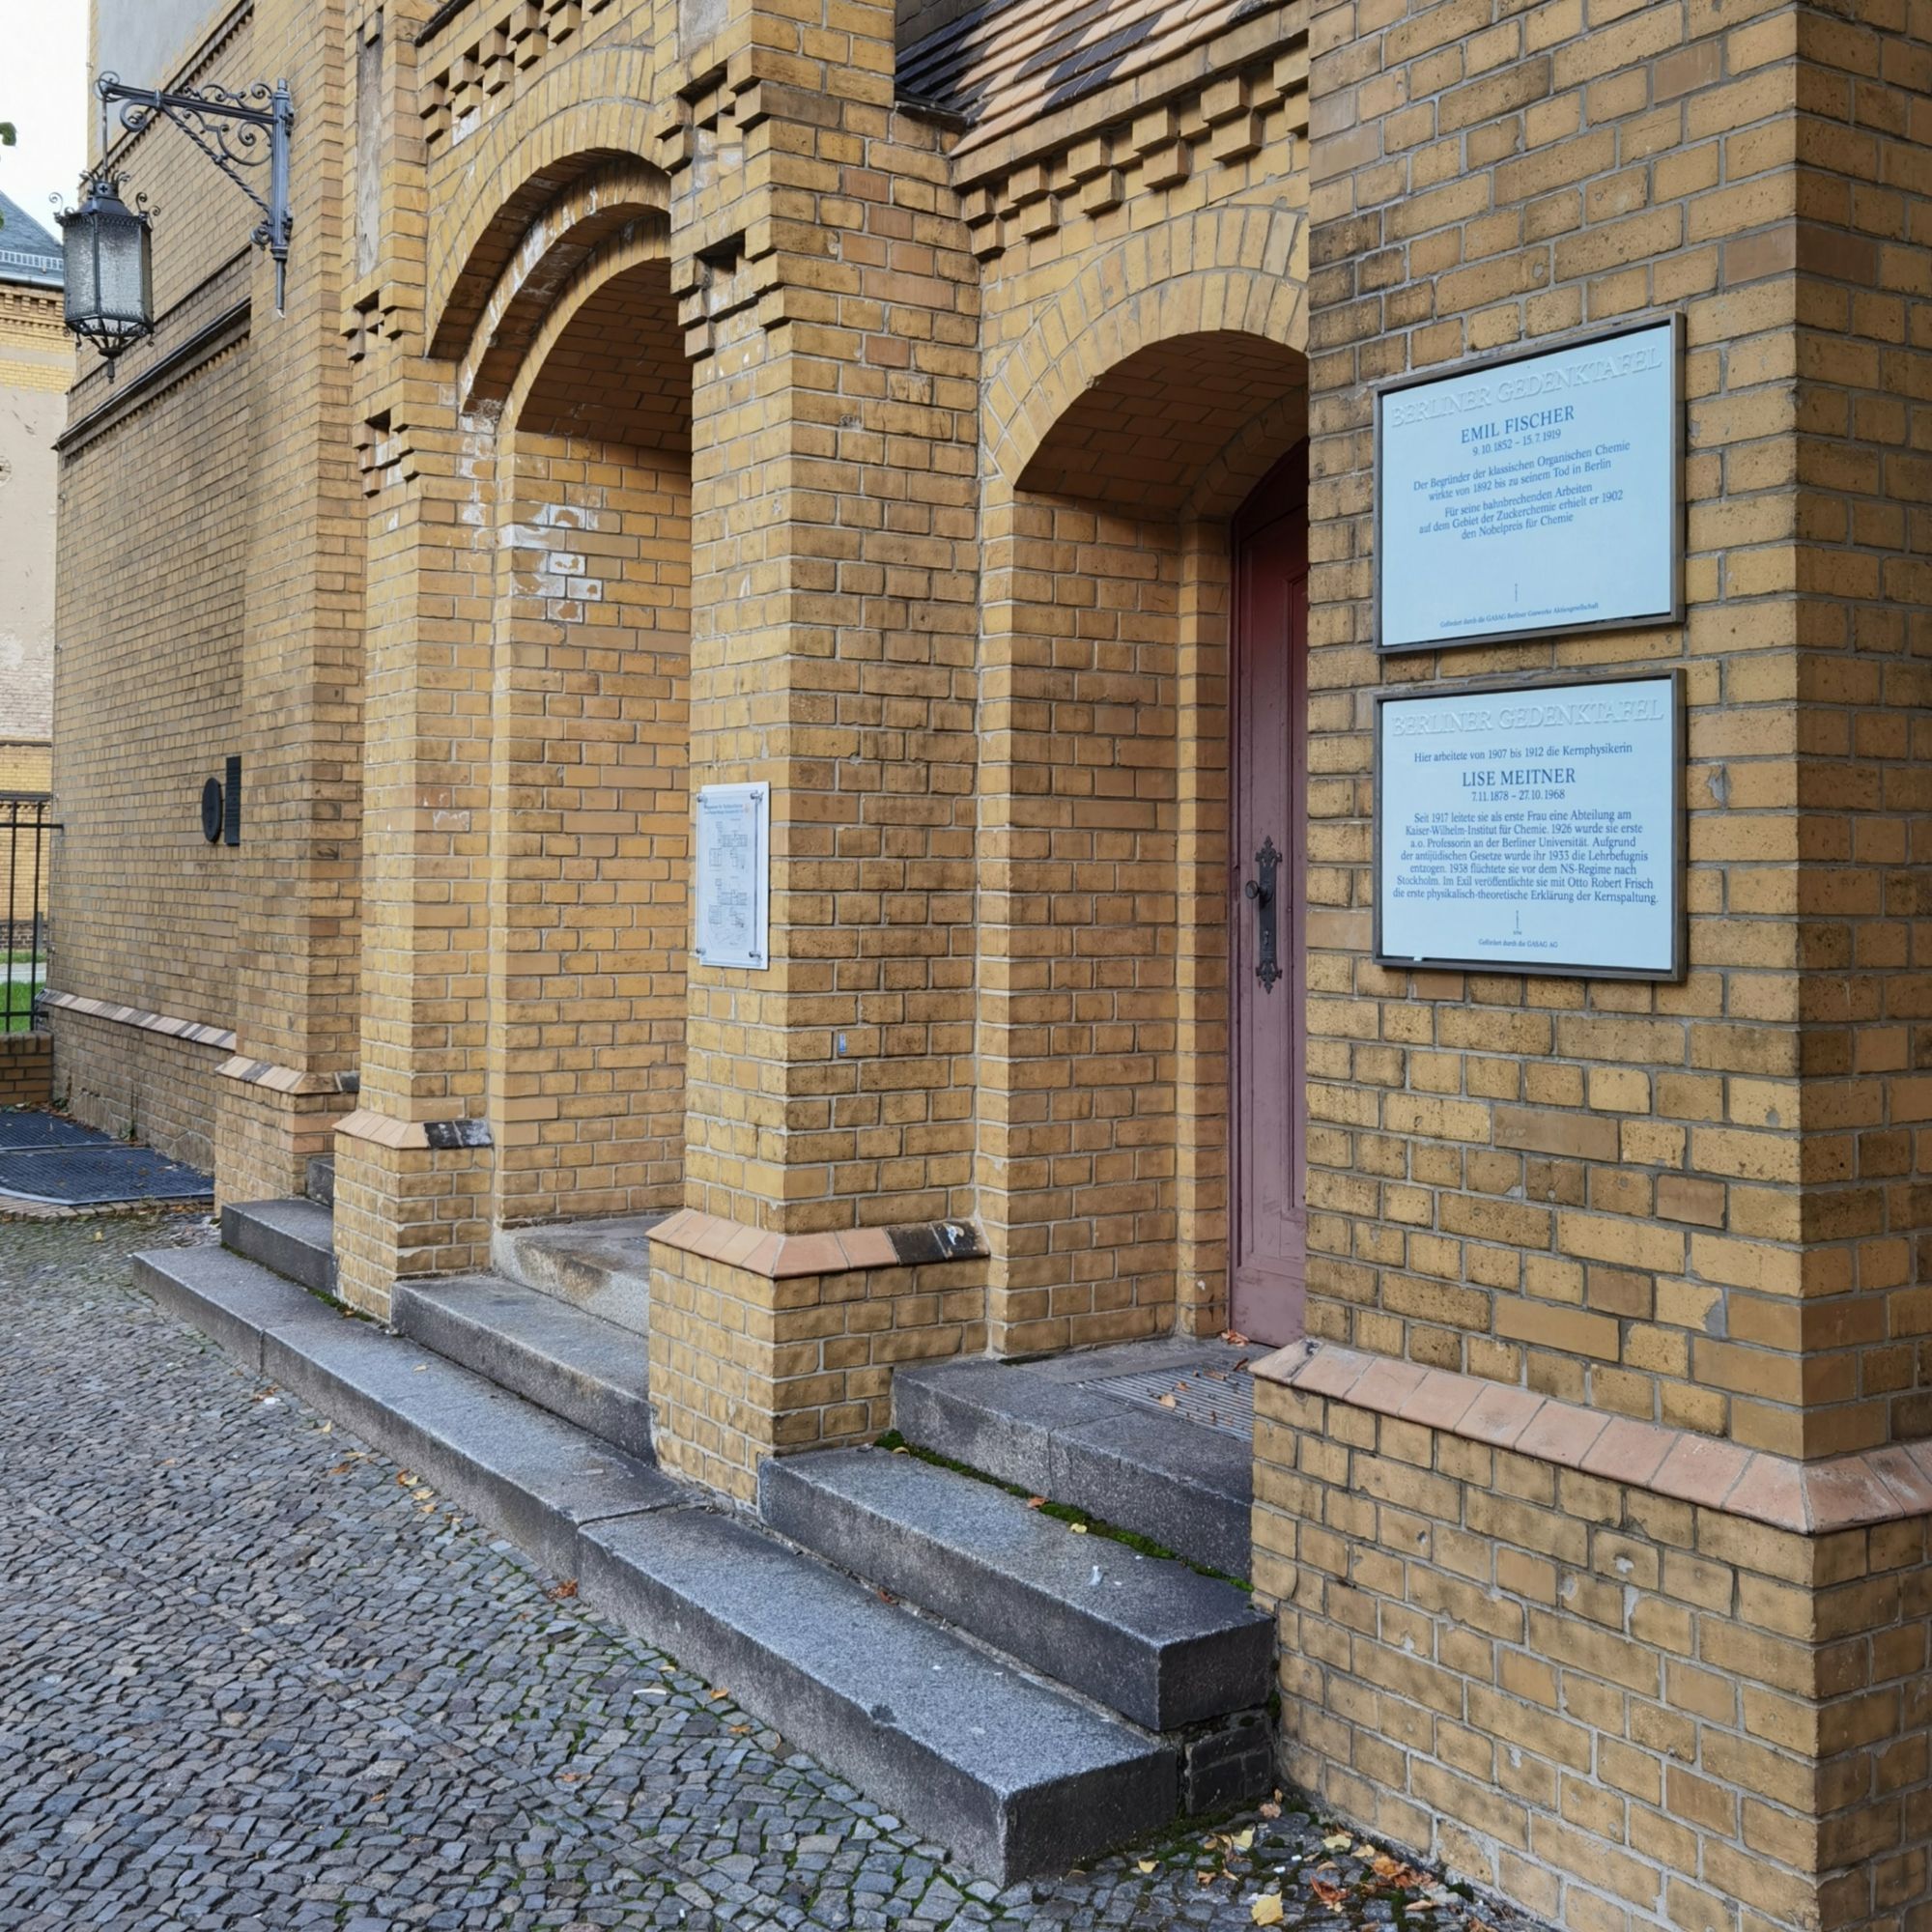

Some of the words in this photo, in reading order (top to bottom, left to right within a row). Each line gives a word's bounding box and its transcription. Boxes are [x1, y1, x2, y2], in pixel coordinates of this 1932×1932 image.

[1391, 387, 1492, 428] BERLINER
[1497, 347, 1662, 403] GEDENKTAFEL
[1461, 422, 1499, 443] EMIL
[1505, 405, 1575, 435] FISCHER
[1413, 481, 1428, 491] Der
[1431, 473, 1470, 490] Begründer
[1473, 469, 1486, 480] der
[1489, 460, 1535, 476] klassischen
[1537, 448, 1592, 468] Organischen
[1595, 440, 1631, 456] Chemie
[1429, 487, 1453, 500] wirkte
[1456, 487, 1470, 497] von
[1474, 481, 1492, 493] 1892
[1494, 478, 1506, 489] bis
[1509, 478, 1519, 487] zu
[1521, 471, 1550, 485] seinem
[1553, 466, 1570, 477] Tod
[1573, 465, 1581, 474] in
[1585, 458, 1611, 471] Berlin
[1445, 506, 1459, 518] Für
[1461, 503, 1481, 515] seine
[1483, 490, 1552, 512] bahnbrechenden
[1555, 484, 1593, 497] Arbeiten
[1419, 523, 1431, 534] auf
[1433, 521, 1450, 531] dem
[1452, 517, 1479, 528] Gebiet
[1481, 513, 1494, 524] der
[1496, 502, 1556, 521] Zuckerchemie
[1559, 496, 1586, 510] erhielt
[1589, 496, 1599, 505] er
[1602, 489, 1623, 503] 1902
[1462, 528, 1476, 540] den
[1479, 521, 1522, 537] Nobelpreis
[1525, 518, 1538, 529] für
[1540, 512, 1574, 526] Chemie
[1391, 711, 1494, 736] BERLINER
[1498, 699, 1664, 729] GEDENKTAFEL
[1414, 752, 1432, 762] Hier
[1434, 751, 1467, 761] arbeitete
[1488, 749, 1507, 759] 1907
[1510, 748, 1521, 758] bis
[1525, 747, 1544, 757] 1912
[1546, 745, 1560, 756] die
[1562, 742, 1633, 757] Kernphysikerin
[1462, 771, 1495, 787] LISE
[1500, 768, 1576, 785] MEITNER
[1414, 812, 1429, 823] Seit
[1432, 812, 1449, 823] 1917
[1451, 811, 1475, 822] leitete
[1477, 811, 1489, 822] sie
[1491, 811, 1502, 821] als
[1504, 812, 1524, 821] erste
[1527, 810, 1547, 821] Frau
[1548, 810, 1568, 821] eine
[1570, 809, 1615, 823] Abteilung
[1617, 810, 1632, 820] am
[1406, 825, 1497, 836] Kaiser-Wilhelm-Institut
[1499, 824, 1511, 835] für
[1514, 824, 1549, 835] Chemie.
[1551, 824, 1572, 834] 1926
[1575, 822, 1605, 833] wurde
[1605, 822, 1619, 833] sie
[1621, 824, 1643, 834] erste
[1410, 839, 1425, 848] a.o.
[1427, 838, 1471, 848] Professorin
[1486, 838, 1499, 847] der
[1501, 838, 1536, 847] Berliner
[1539, 837, 1589, 847] Universität.
[1592, 837, 1636, 850] Aufgrund
[1401, 850, 1413, 861] der
[1415, 850, 1467, 862] antijüdischen
[1469, 850, 1502, 861] Gesetze
[1504, 850, 1530, 861] wurde
[1533, 850, 1546, 861] ihr
[1548, 850, 1569, 861] 1933
[1572, 850, 1586, 861] die
[1588, 850, 1648, 864] Lehrbefugnis
[1470, 863, 1506, 873] flüchtete
[1508, 864, 1520, 874] sie
[1521, 866, 1536, 874] vor
[1538, 863, 1557, 874] dem
[1560, 863, 1612, 877] NS-Regime
[1614, 864, 1637, 875] nach
[1443, 876, 1454, 886] Im
[1456, 875, 1472, 886] Exil
[1475, 875, 1534, 887] veröffentlichte
[1536, 876, 1548, 887] sie
[1550, 876, 1565, 888] mit
[1567, 877, 1589, 888] Otto
[1591, 877, 1622, 889] Robert
[1624, 877, 1654, 890] Frisch
[1392, 888, 1405, 897] die
[1406, 889, 1424, 898] erste
[1427, 889, 1528, 900] physikalisch-theoretische
[1531, 890, 1575, 903] Erklärung
[1577, 890, 1591, 901] der
[1594, 891, 1659, 906] Kernspaltung.
